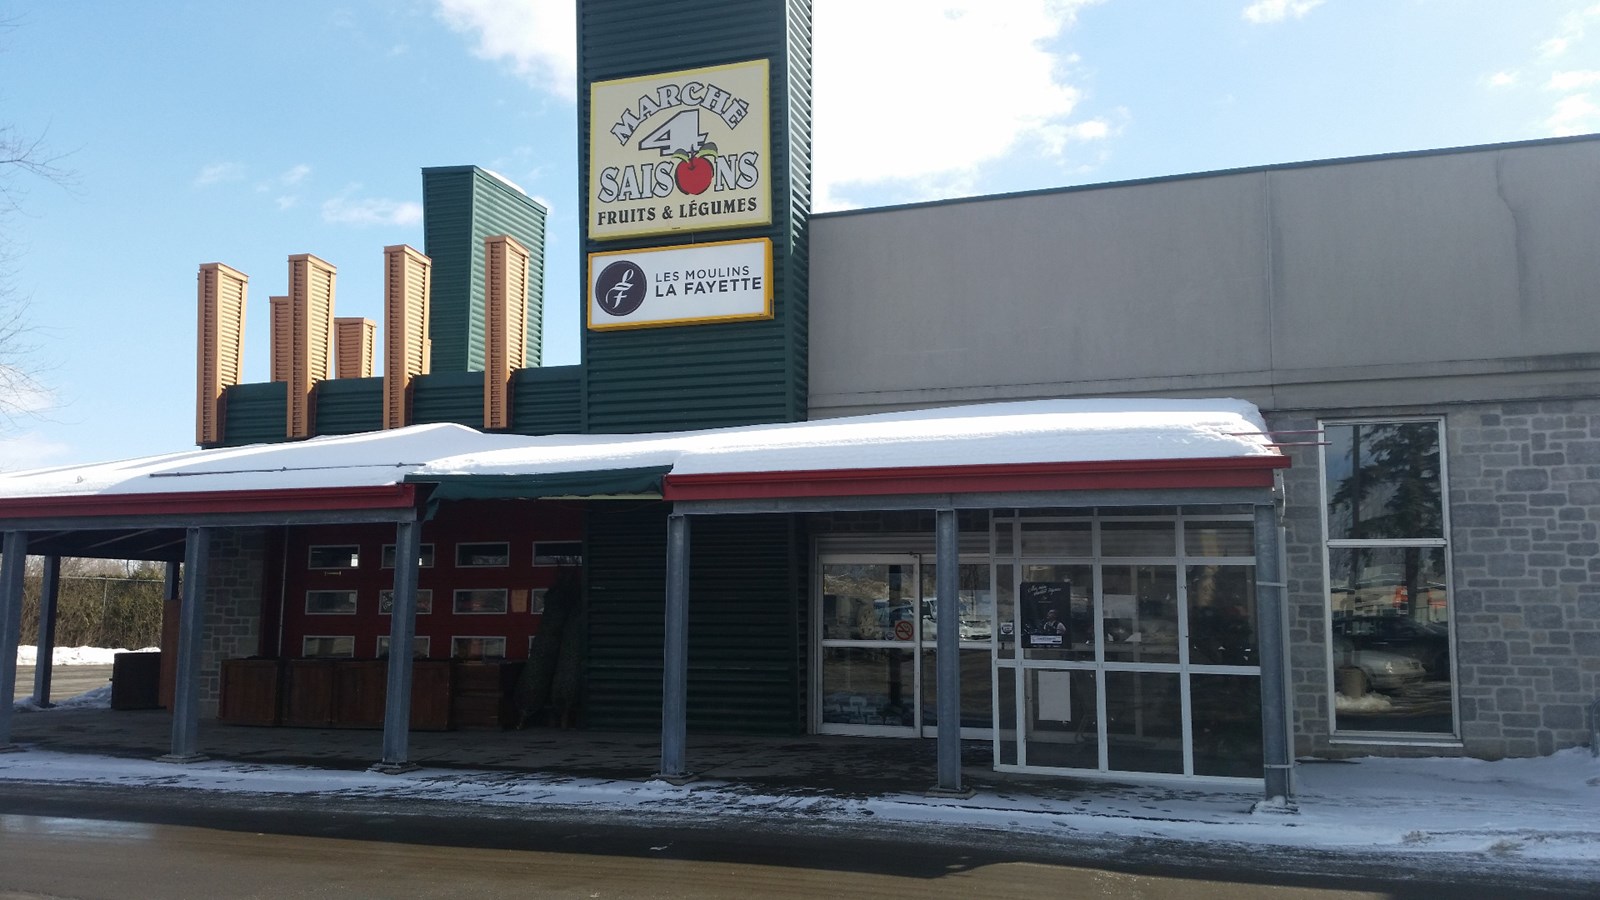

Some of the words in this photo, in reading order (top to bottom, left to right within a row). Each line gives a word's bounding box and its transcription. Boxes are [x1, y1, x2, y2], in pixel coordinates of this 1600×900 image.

[638, 108, 709, 157] 4
[597, 206, 656, 226] FRUITS
[662, 205, 673, 219] &
[679, 200, 757, 218] LÉGUMES
[655, 271, 680, 282] LES
[685, 266, 750, 281] MOULINS
[655, 283, 677, 298] LA
[684, 276, 762, 296] FAYETTE
